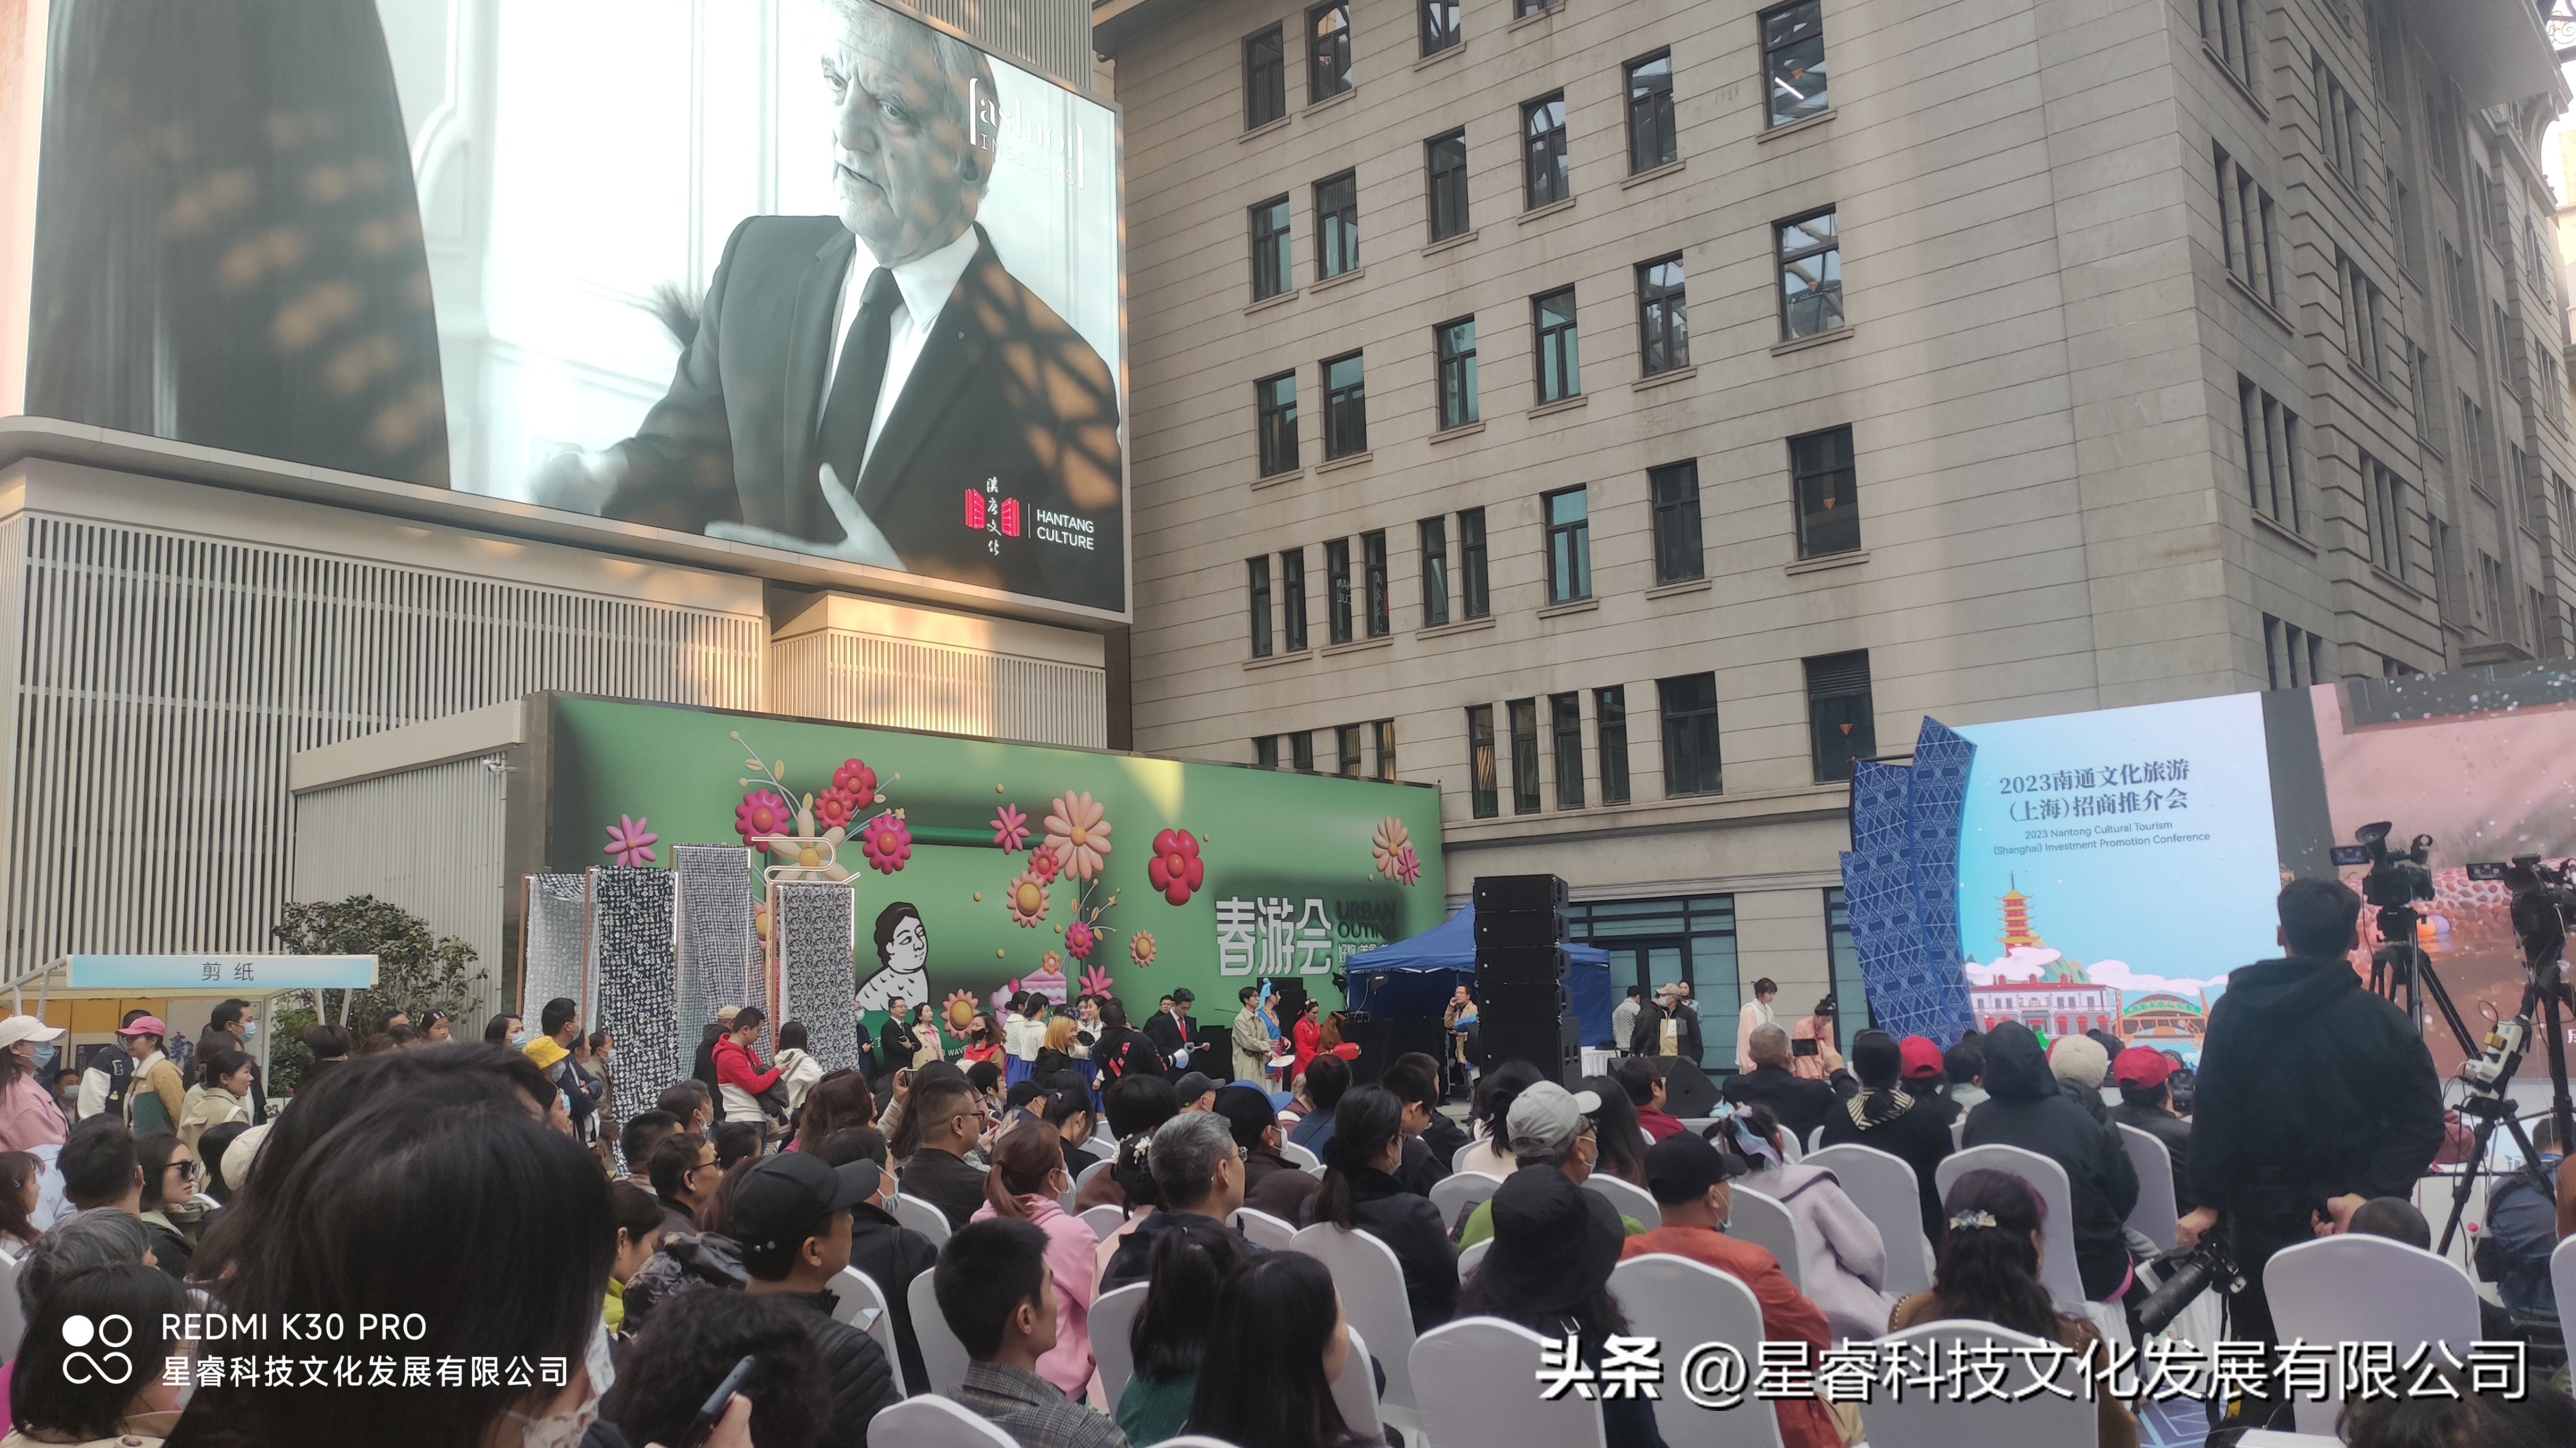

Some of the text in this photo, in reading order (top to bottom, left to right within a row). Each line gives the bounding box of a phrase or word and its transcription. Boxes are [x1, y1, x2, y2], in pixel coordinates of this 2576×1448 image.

[1036, 508, 1094, 533] HANTANG
[1036, 526, 1094, 550] CULTURE
[1999, 758, 2191, 795] 2023南通文化旅游
[2025, 821, 2173, 840] 2023 Nantong Cultural Tourism
[1994, 833, 2211, 856] (Shanghai) Investment Promotion Conference
[1336, 900, 1397, 921] URBAN
[1215, 896, 1332, 976] 春游会
[1338, 921, 1397, 941] OUTING
[201, 962, 254, 981] 剪纸
